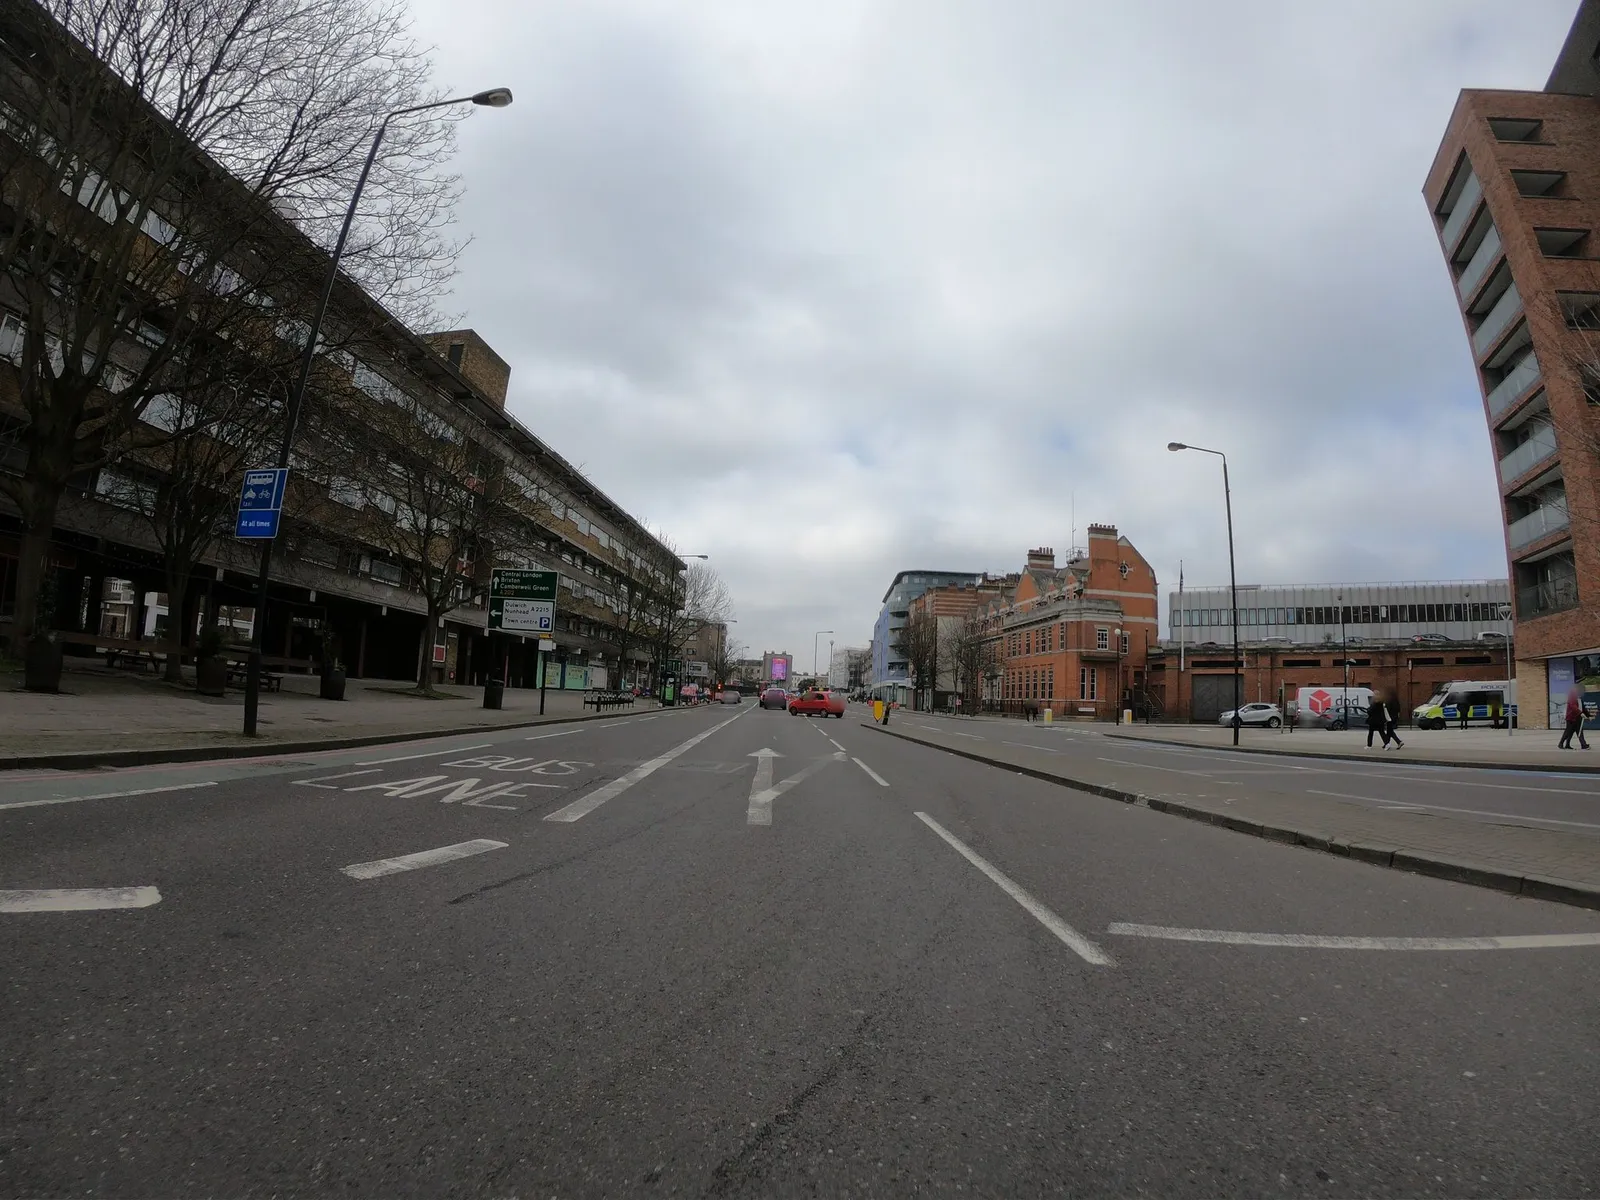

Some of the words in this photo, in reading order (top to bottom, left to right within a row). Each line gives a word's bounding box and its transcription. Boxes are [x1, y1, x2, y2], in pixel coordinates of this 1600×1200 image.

[1335, 695, 1359, 706] dpd
[439, 754, 596, 775] BUS
[290, 769, 569, 810] LANE
